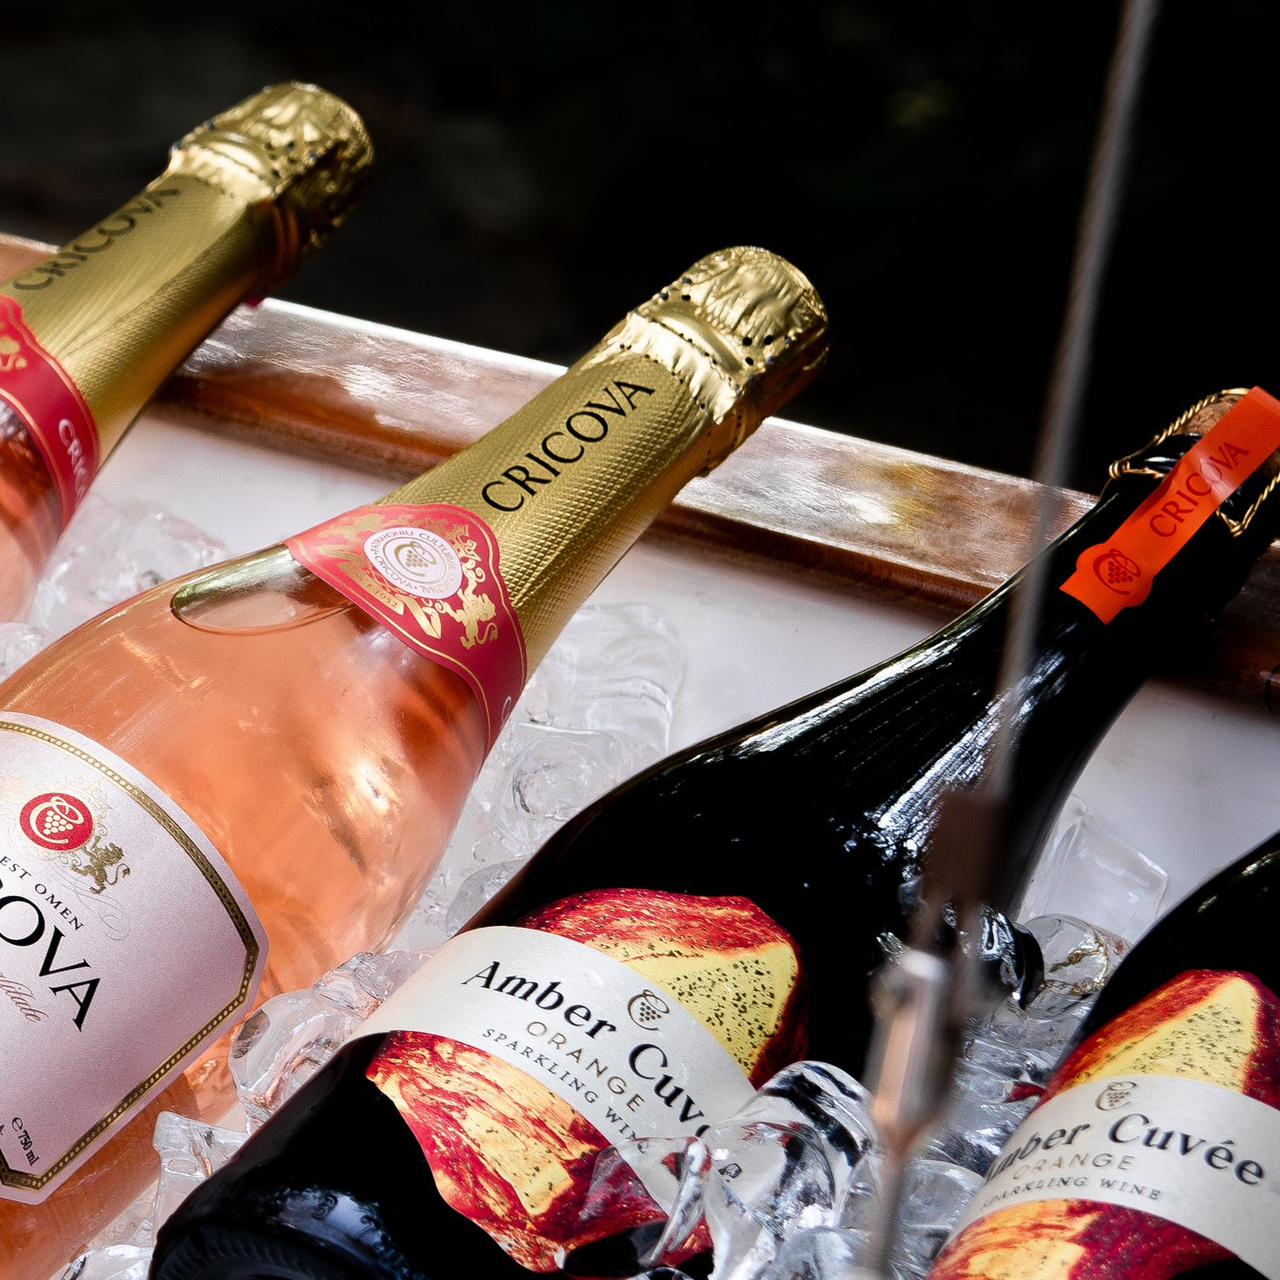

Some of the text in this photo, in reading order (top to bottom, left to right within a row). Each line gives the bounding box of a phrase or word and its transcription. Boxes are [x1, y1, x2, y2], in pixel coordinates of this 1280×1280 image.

[481, 378, 655, 513] CRICOVA
[1149, 441, 1250, 538] CRICOVA
[34, 882, 85, 932] OMEN
[461, 960, 711, 1138] Amber Cuv
[482, 1027, 600, 1106] SPARKLING
[526, 1020, 648, 1113] ORANGE
[17, 1130, 35, 1154] 750
[25, 1150, 41, 1167] ml
[1013, 1151, 1136, 1180] ORANGE
[1108, 1113, 1265, 1187] Cuvée
[1100, 1177, 1162, 1201] WINE
